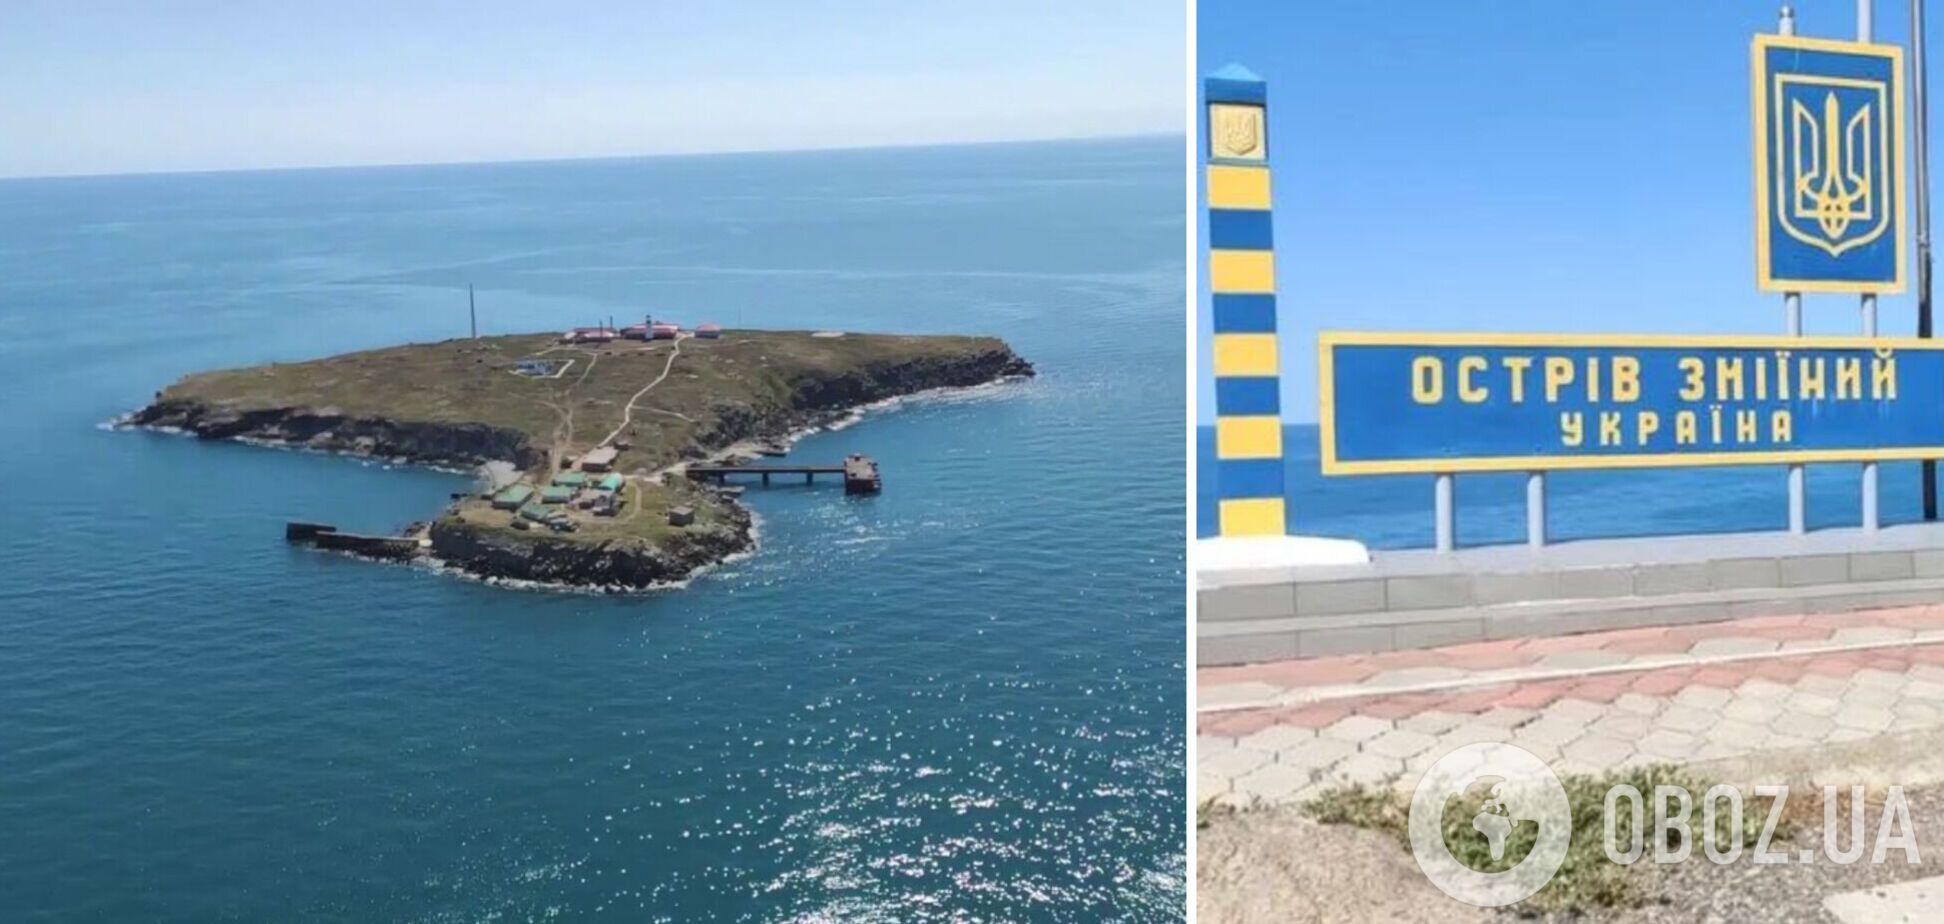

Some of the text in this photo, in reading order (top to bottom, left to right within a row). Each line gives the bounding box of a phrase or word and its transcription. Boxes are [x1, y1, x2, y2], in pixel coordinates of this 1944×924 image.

[1412, 348, 1896, 403] ОСТРІВ ЗМІЇНИЙ
[1561, 406, 1792, 446] УКРАЇНА
